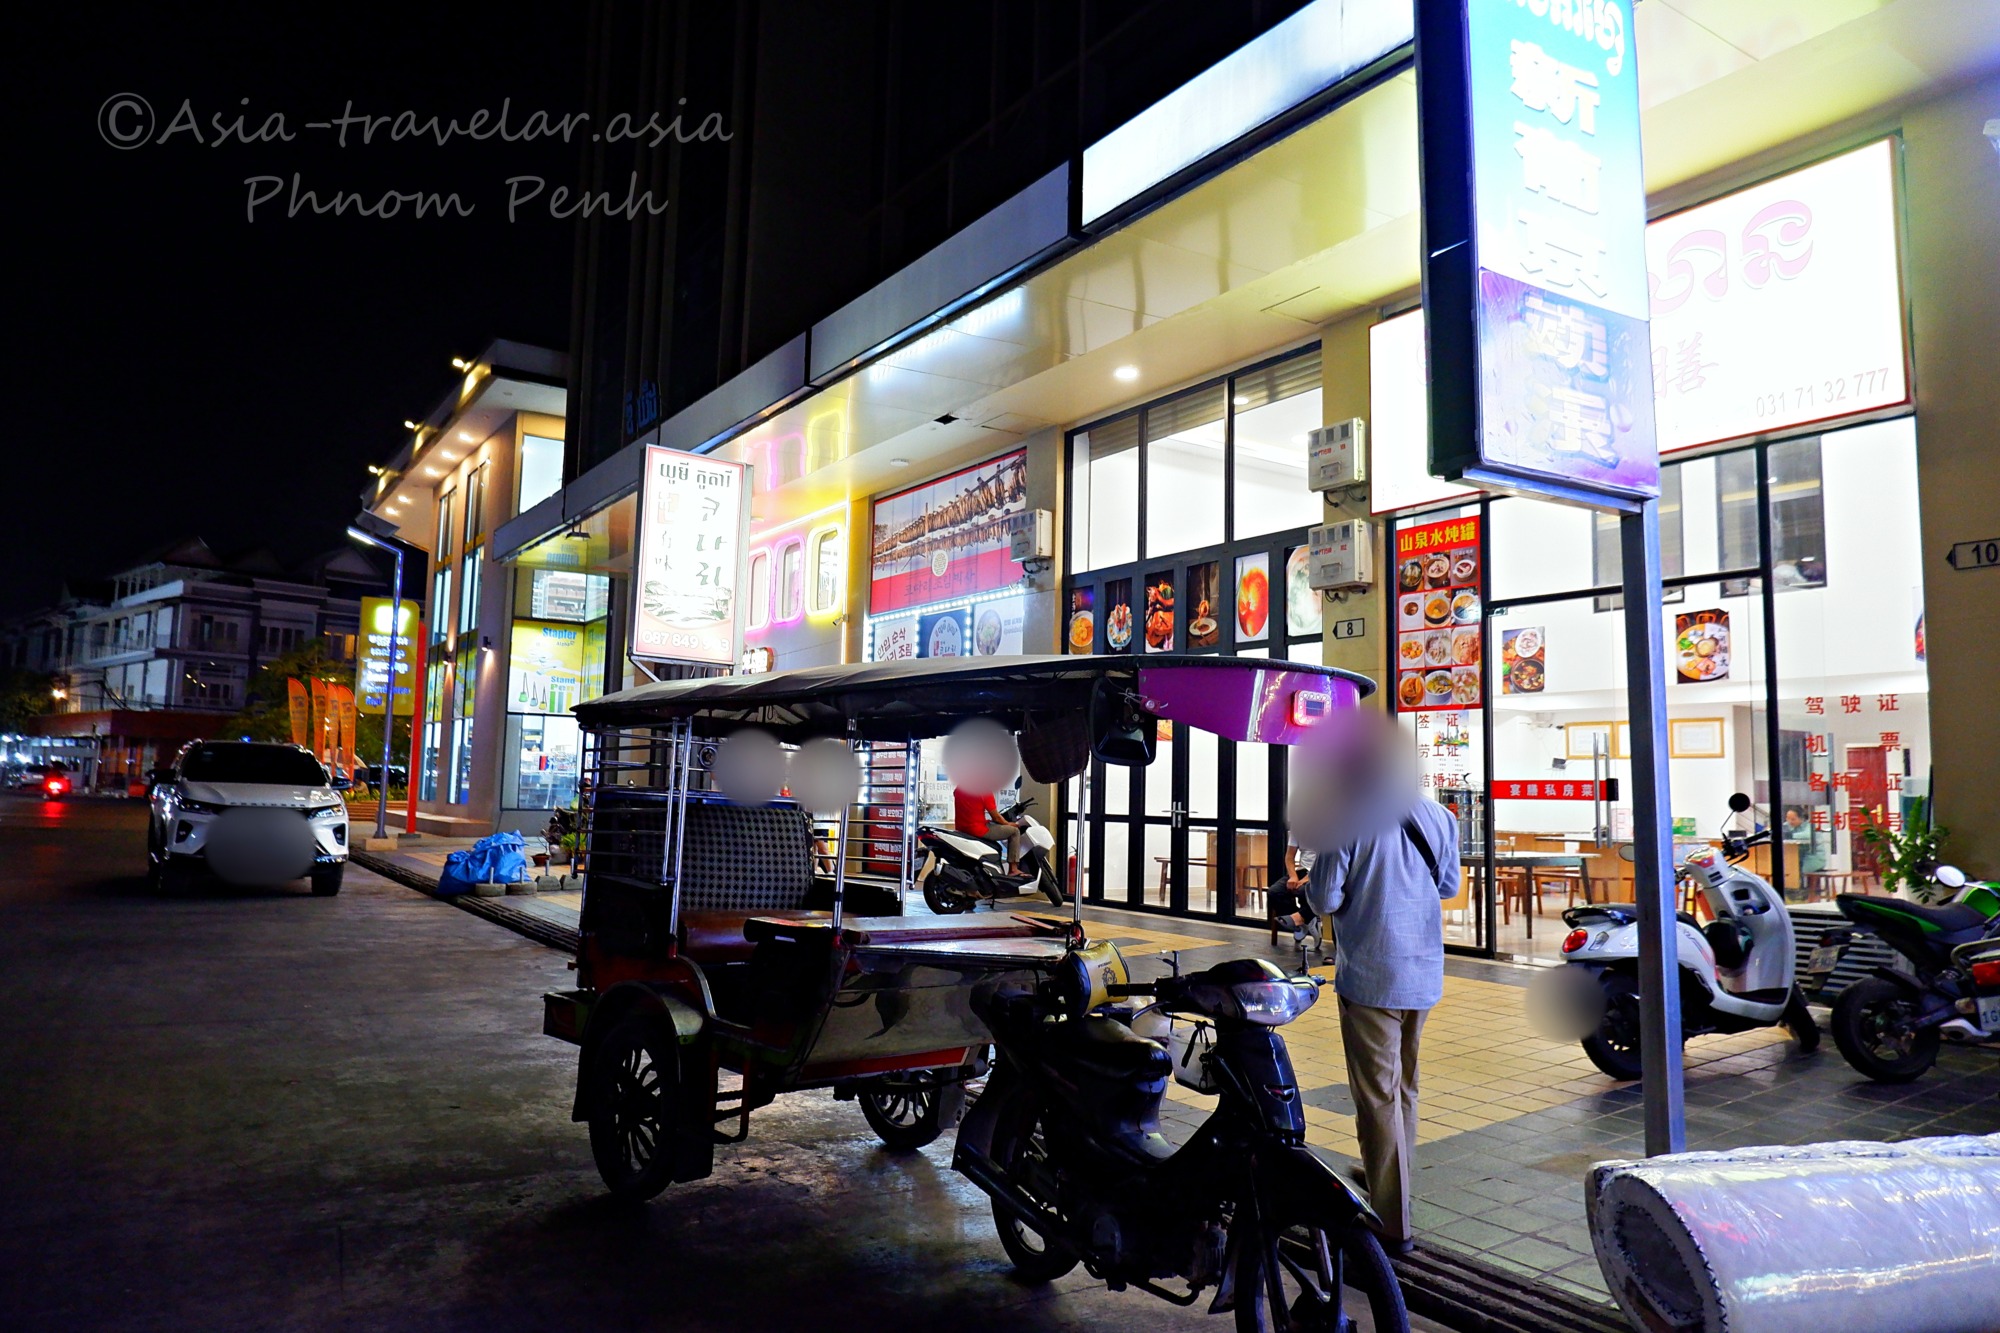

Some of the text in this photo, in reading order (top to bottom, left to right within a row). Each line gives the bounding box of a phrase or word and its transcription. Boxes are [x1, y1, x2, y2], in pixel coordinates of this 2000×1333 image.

[1756, 367, 1889, 417] 031 71 32 777
[1400, 521, 1476, 552] 山泉水炖罐
[1972, 543, 1999, 564] 10
[542, 627, 577, 640] Stapler
[1345, 622, 1354, 636] 8
[672, 633, 699, 649] 849
[550, 675, 576, 684] Stand
[1804, 693, 1900, 716] 驾驶证
[1418, 743, 1461, 759] 劳工证
[1417, 772, 1460, 788] 结婚证
[1809, 810, 1904, 832] 手机号
